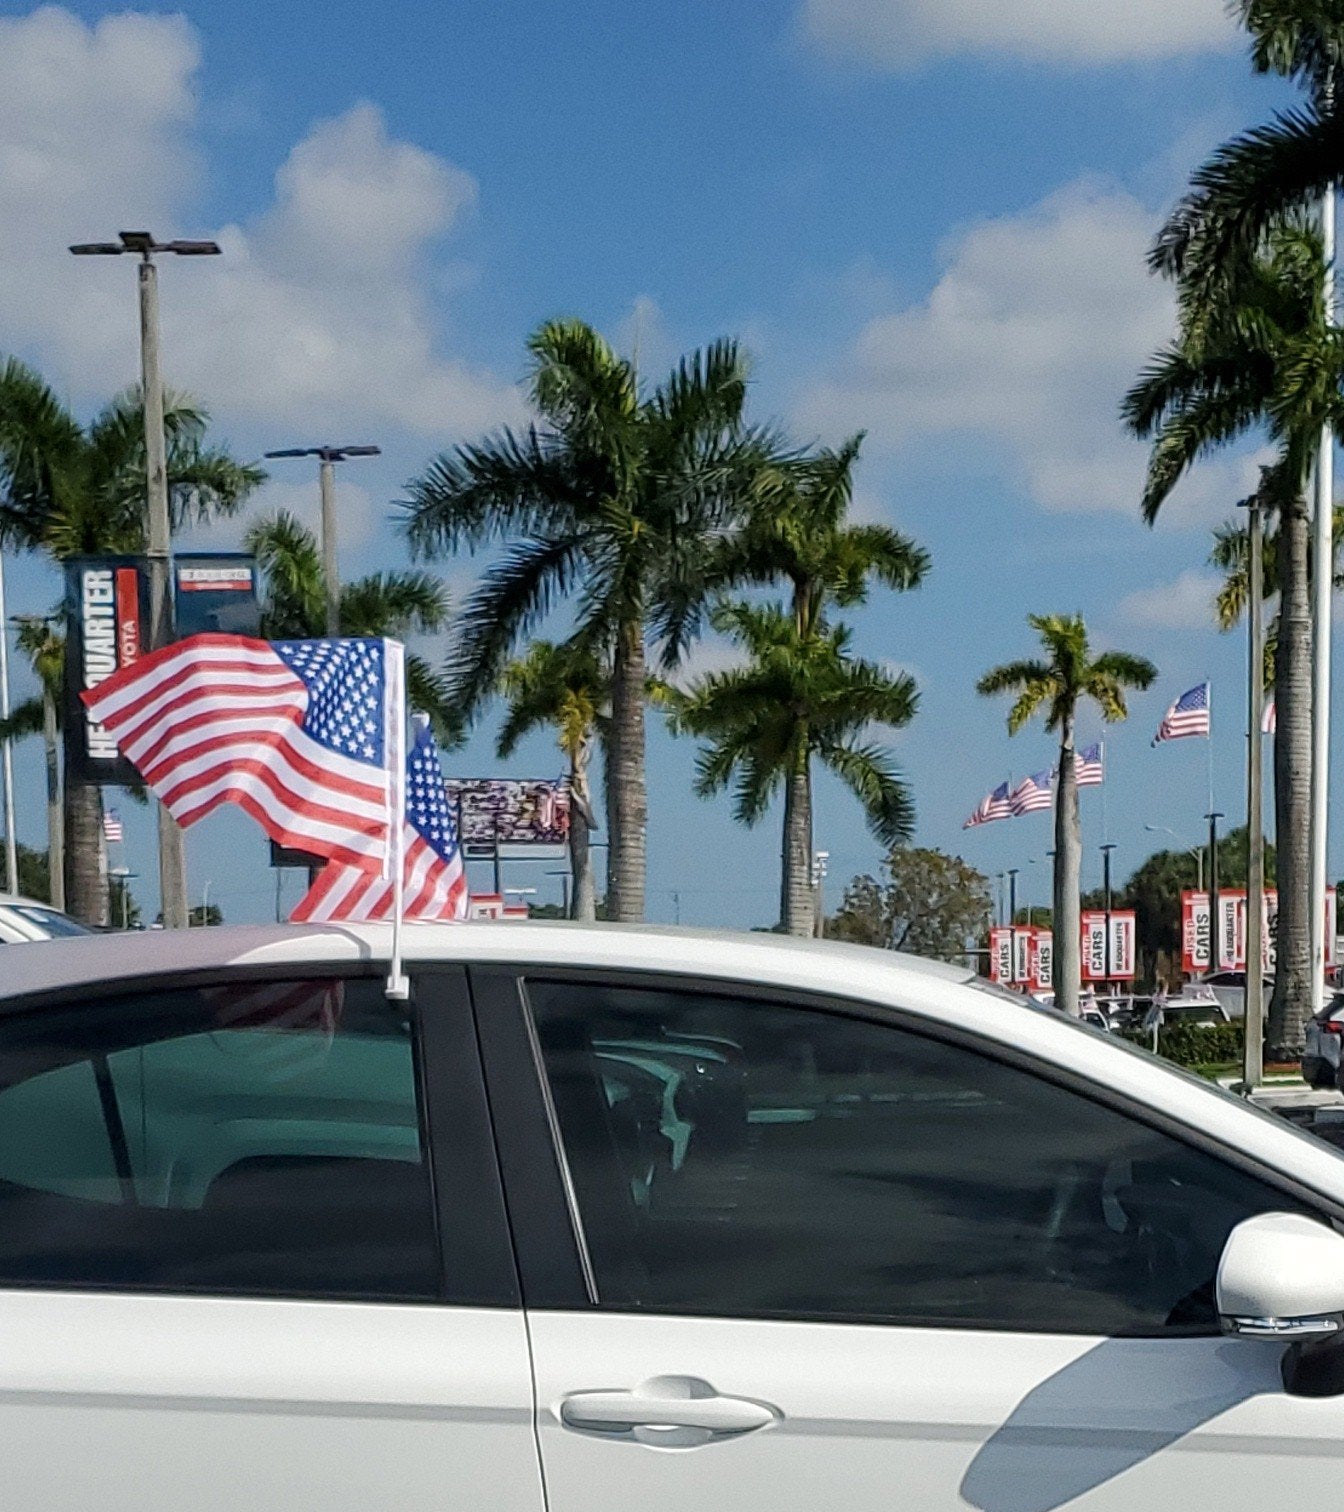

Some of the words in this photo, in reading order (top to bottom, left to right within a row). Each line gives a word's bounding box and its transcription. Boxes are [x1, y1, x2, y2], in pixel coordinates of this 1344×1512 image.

[121, 620, 137, 668] YOTA
[1092, 930, 1103, 971] CARS
[1196, 913, 1209, 960] CARS
[1000, 943, 1009, 978] CARS
[1040, 947, 1050, 983] CARS
